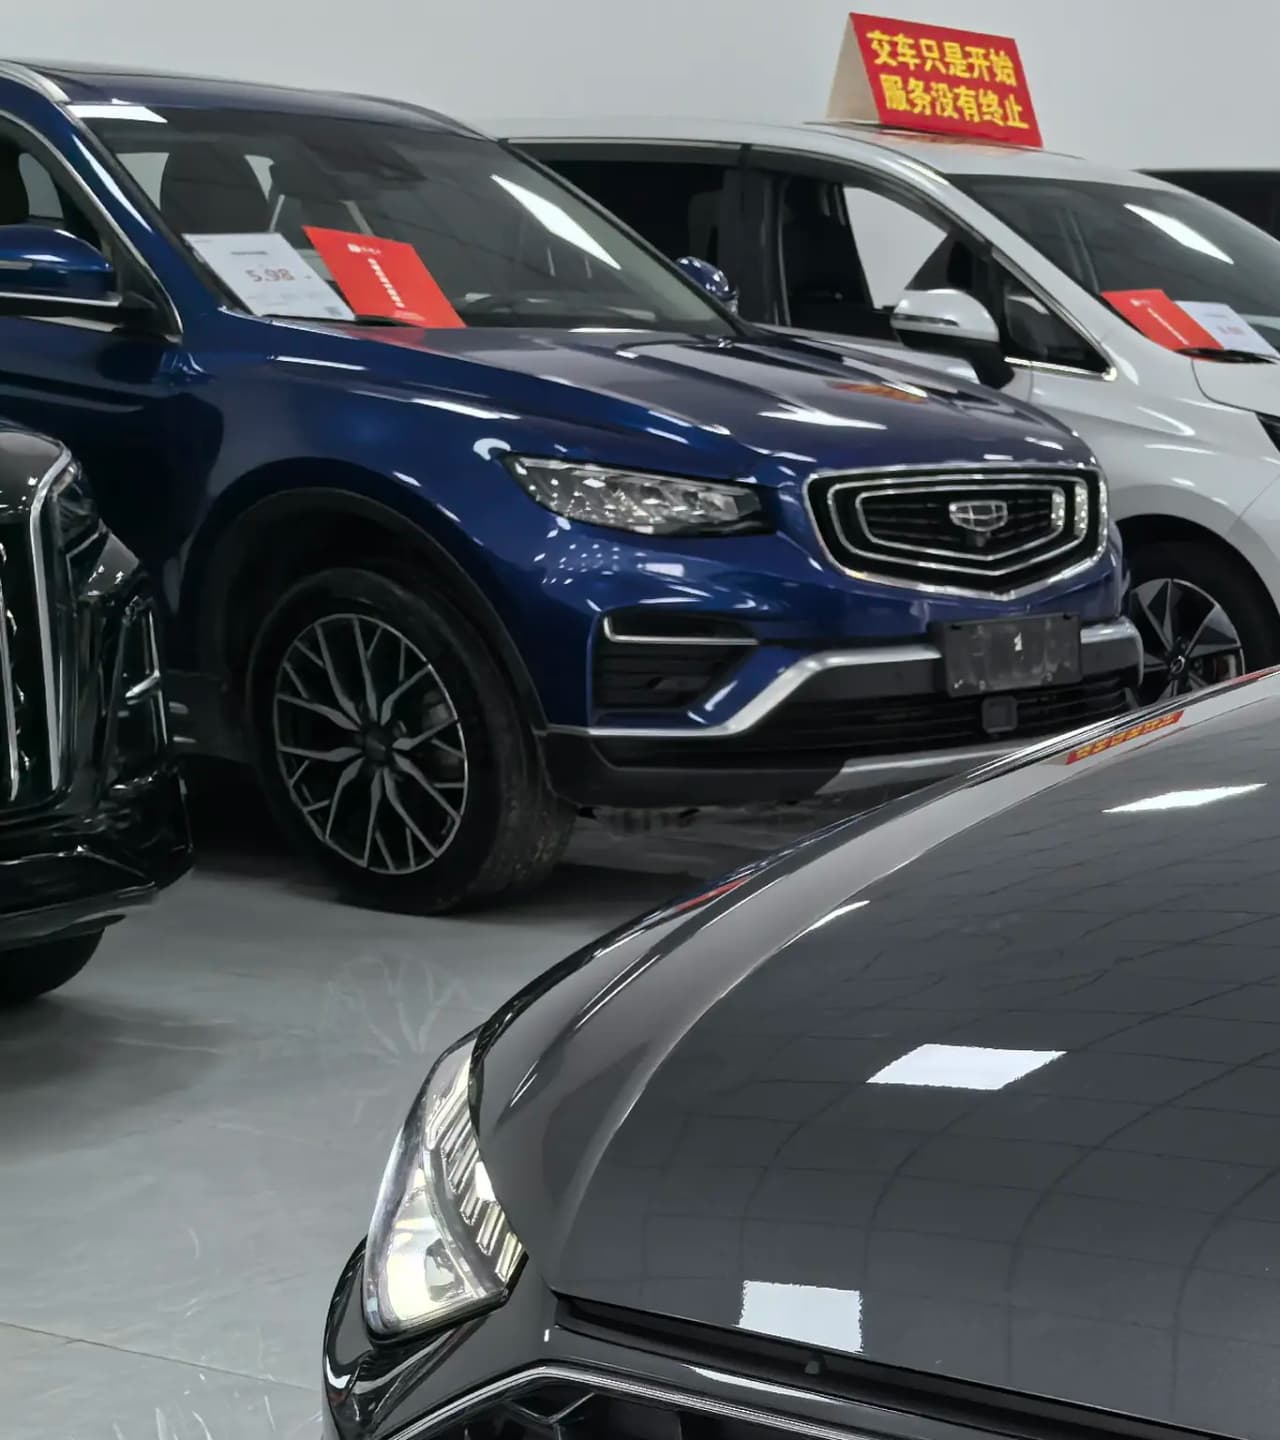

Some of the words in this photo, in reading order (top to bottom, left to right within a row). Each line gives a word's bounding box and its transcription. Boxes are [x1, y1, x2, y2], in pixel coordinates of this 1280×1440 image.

[866, 30, 1017, 87] 交车只是开始
[879, 73, 1029, 129] 服务没有终止
